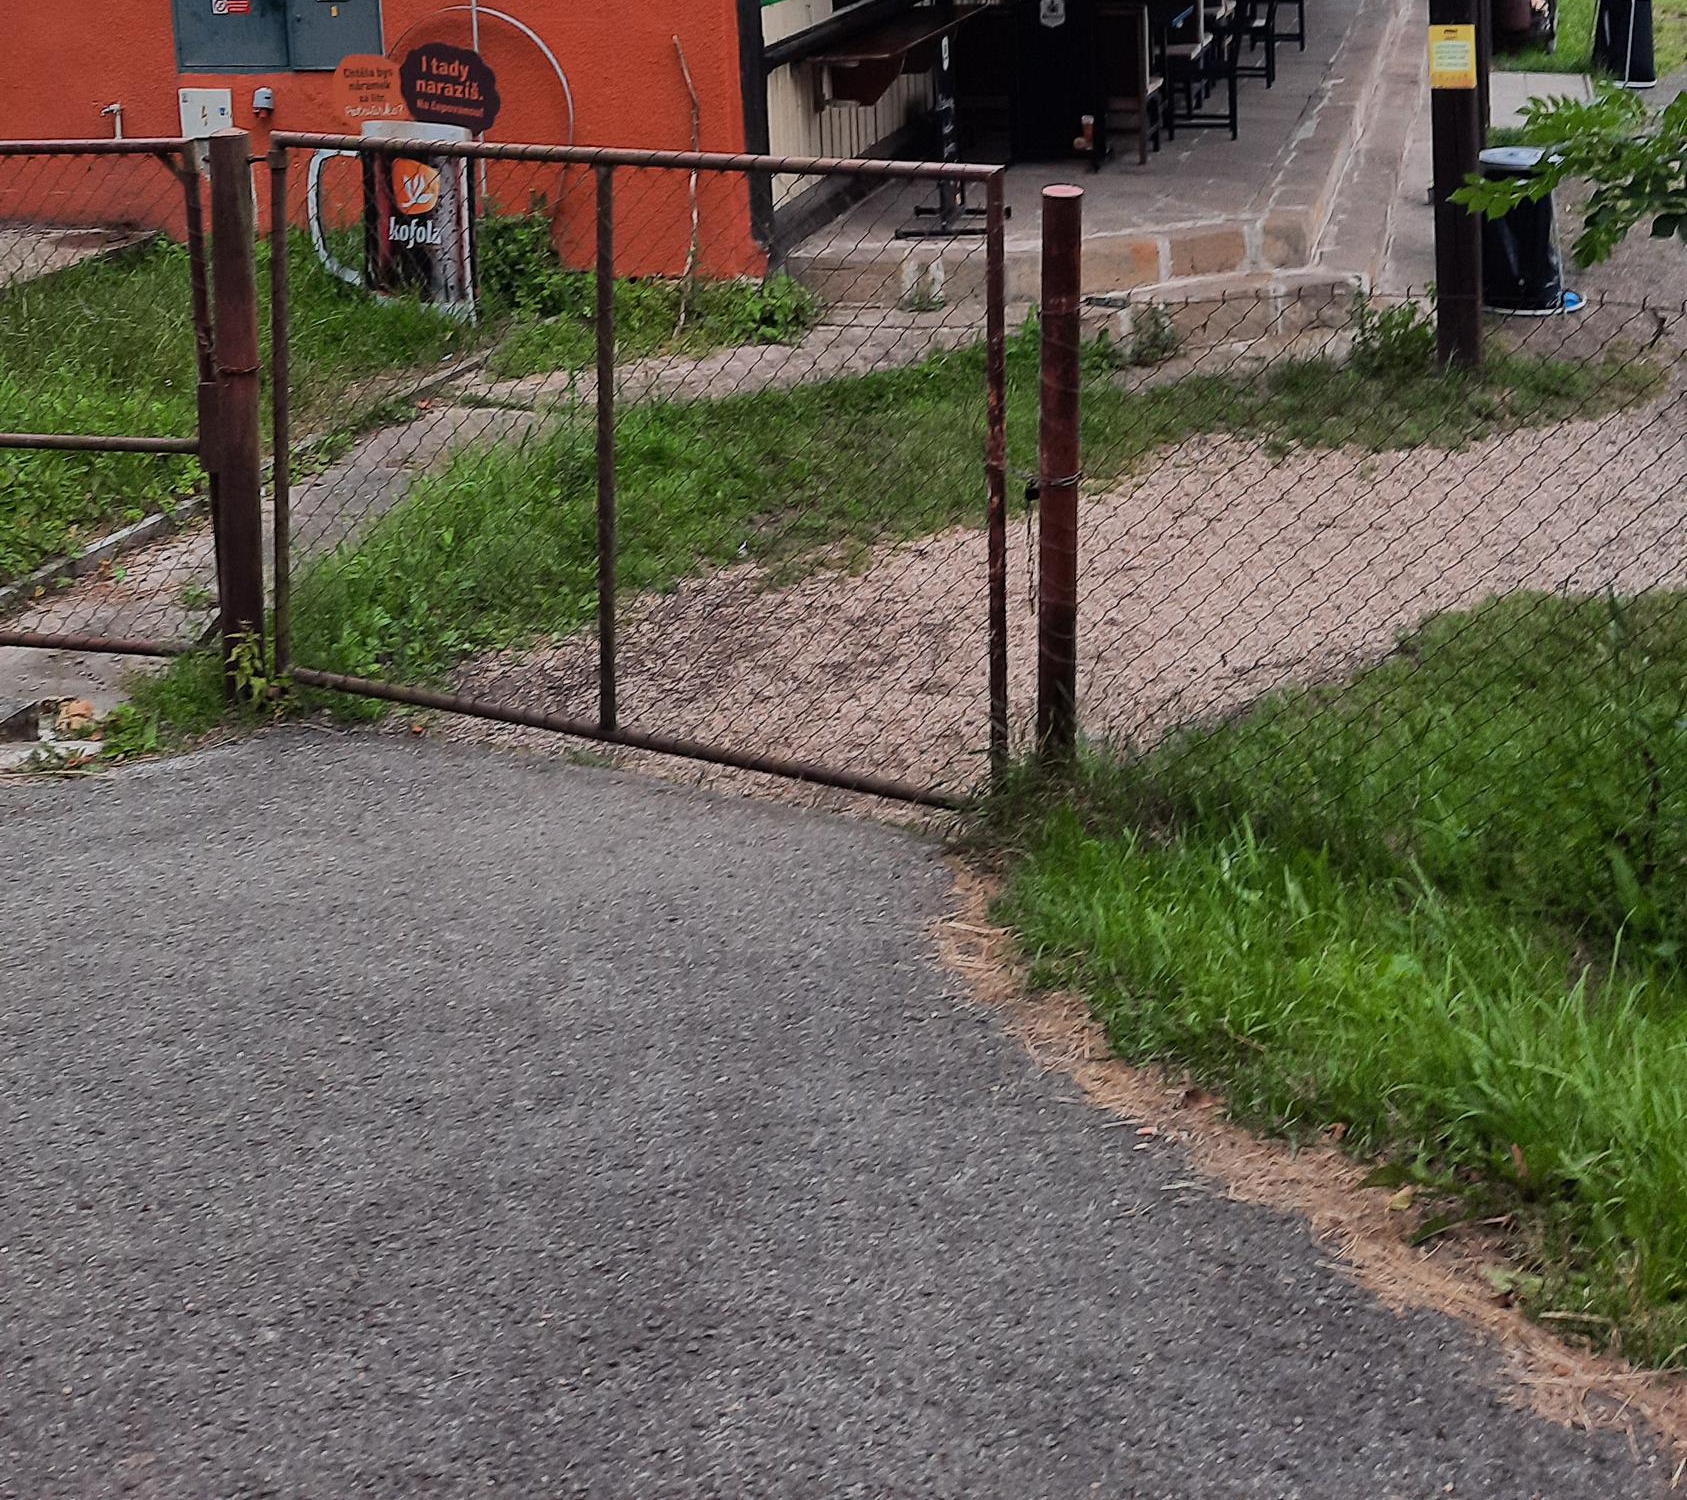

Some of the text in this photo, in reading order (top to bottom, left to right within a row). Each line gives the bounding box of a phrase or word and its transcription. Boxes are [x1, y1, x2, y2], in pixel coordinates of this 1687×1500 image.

[421, 55, 470, 80] I tady
[388, 216, 441, 249] kofola
